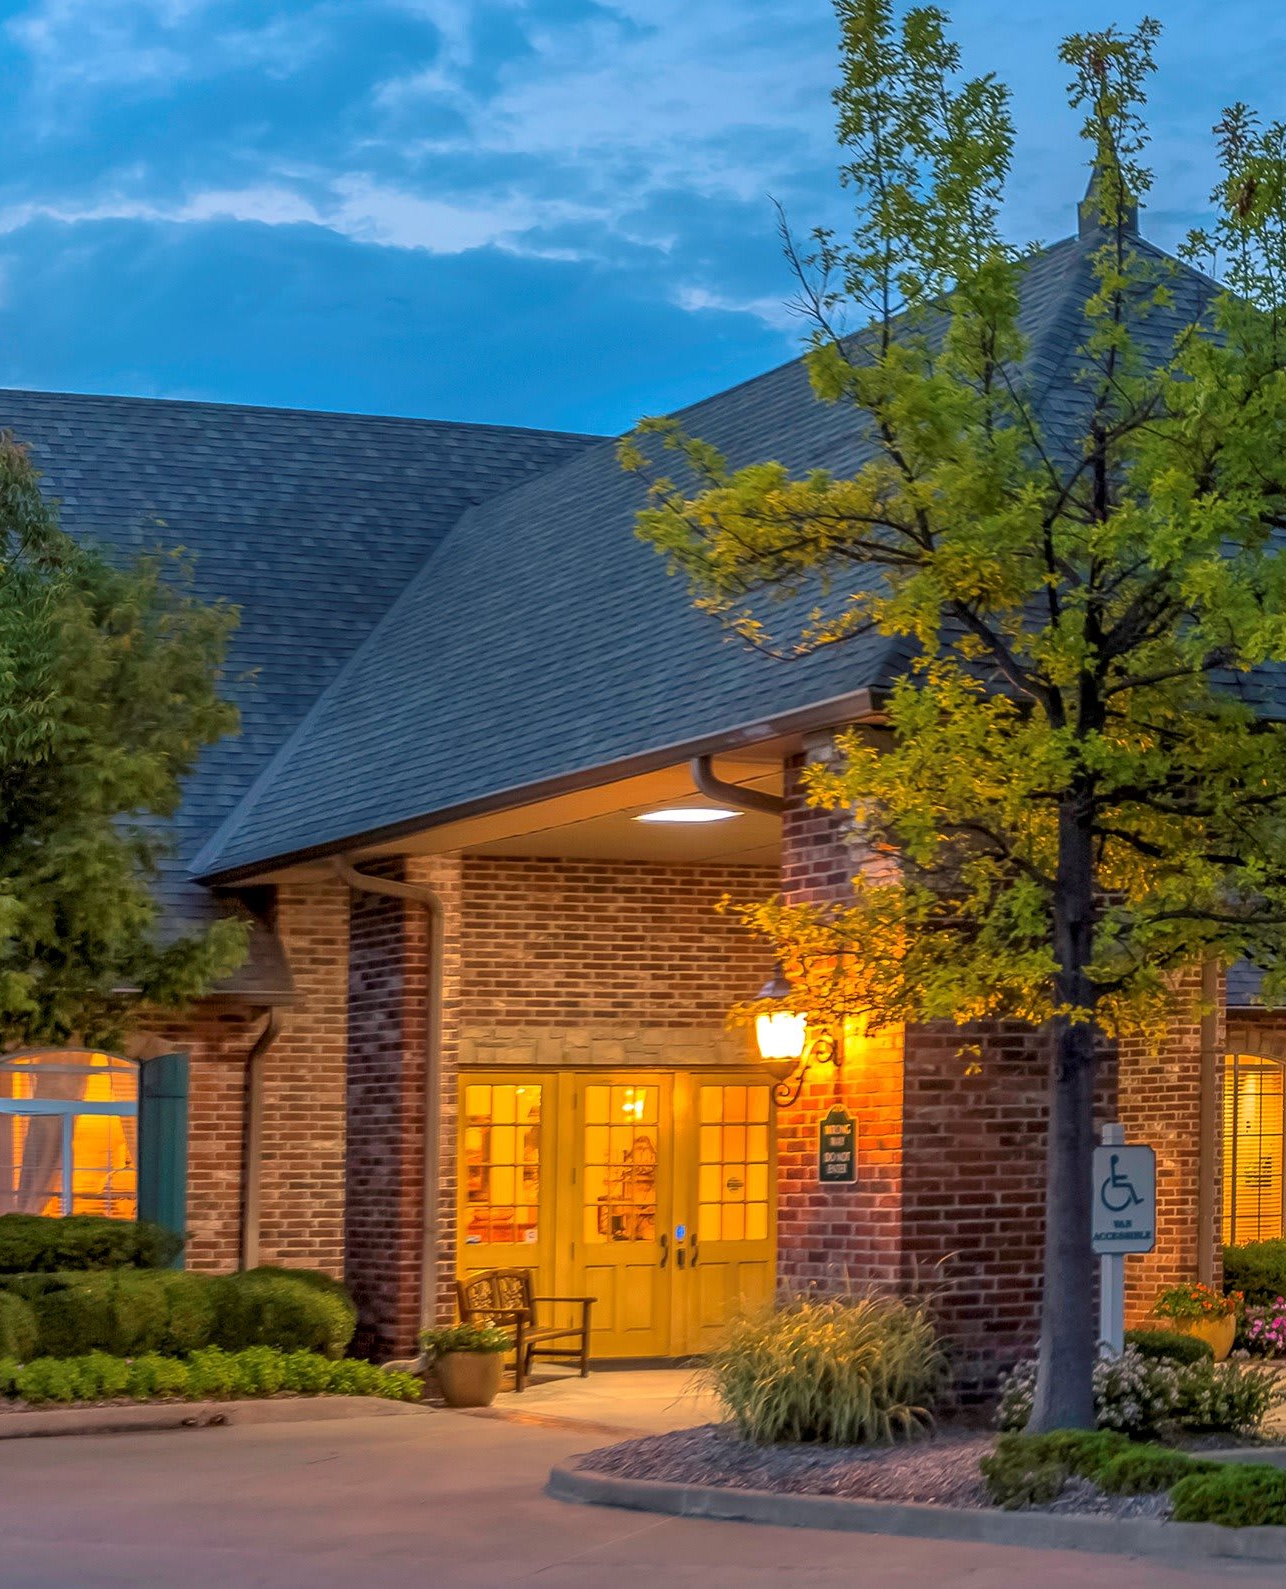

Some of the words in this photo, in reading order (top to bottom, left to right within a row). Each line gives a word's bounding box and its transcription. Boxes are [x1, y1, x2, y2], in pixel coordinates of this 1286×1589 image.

[824, 1152, 836, 1162] DO
[837, 1152, 851, 1162] NOT
[1113, 1219, 1133, 1228] VAN
[1093, 1231, 1152, 1240] ACCESSIBLE
